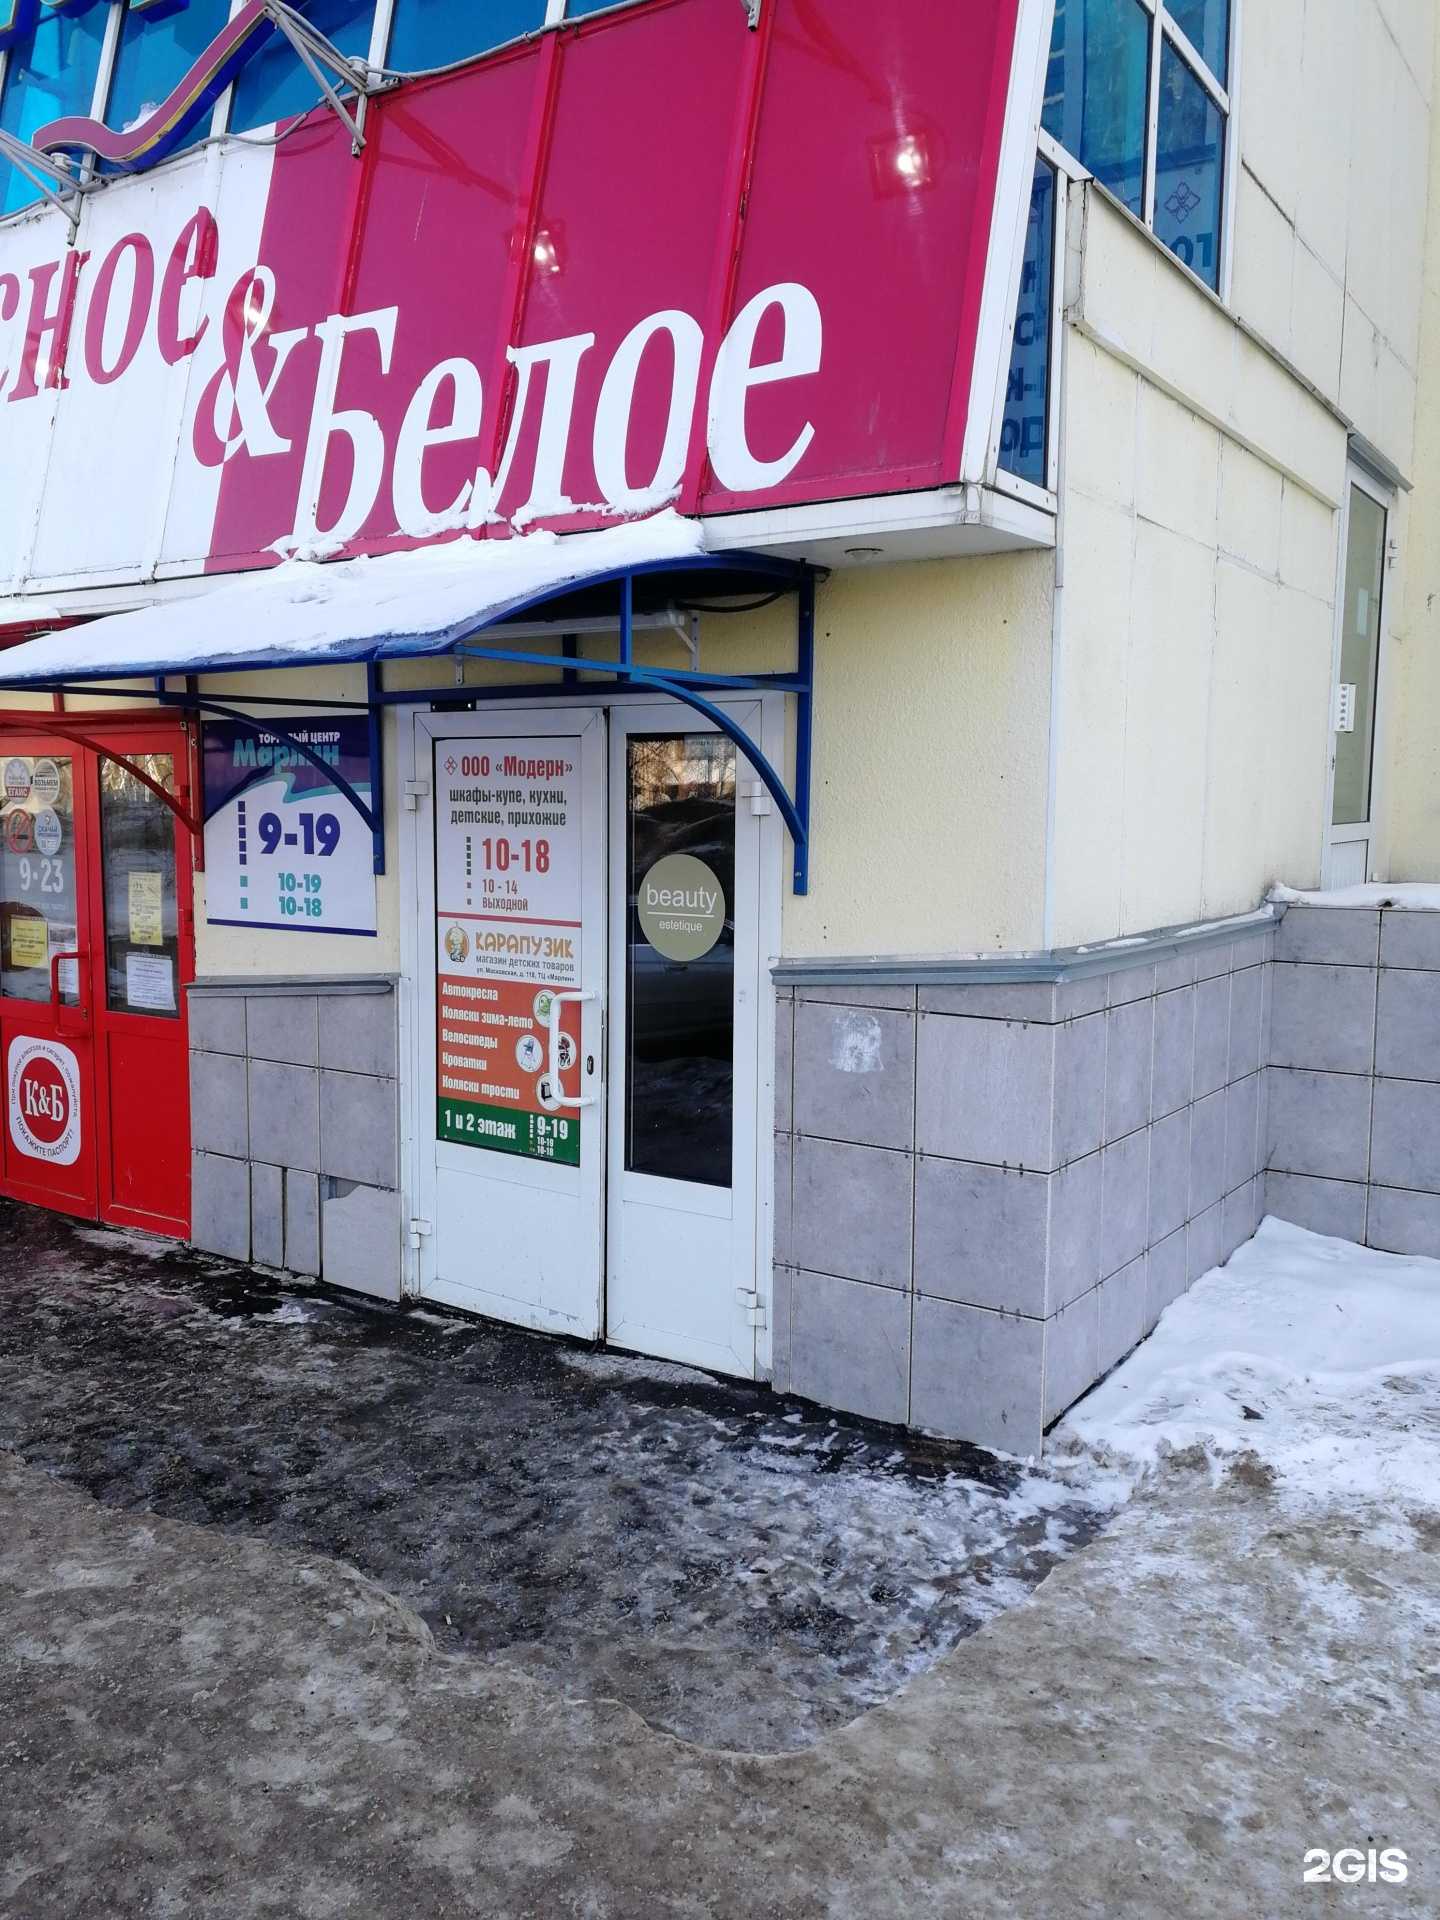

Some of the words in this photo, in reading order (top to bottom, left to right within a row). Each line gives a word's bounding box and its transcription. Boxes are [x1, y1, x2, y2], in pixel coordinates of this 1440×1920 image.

[291, 282, 823, 542] Белое
[310, 732, 340, 745] ЦЕНТР
[461, 756, 490, 776] ООО
[495, 756, 573, 781] «Модерн»
[449, 787, 526, 806] шкафы-купе,
[529, 790, 567, 807] кухни,
[451, 810, 504, 826] детские,
[508, 811, 566, 827] прихожие
[258, 812, 340, 856] 9-19
[482, 838, 550, 873] 10-18
[278, 872, 322, 893] 10-19
[482, 879, 495, 893] 10
[506, 880, 518, 894] 14
[278, 896, 322, 917] 10-18
[647, 883, 717, 913] beauty
[658, 918, 703, 932] estetique
[475, 931, 574, 959] КАРАПУЗИК
[476, 955, 507, 966] магазин
[509, 957, 540, 969] детских
[543, 961, 575, 973] товаров
[442, 982, 498, 1001] Автокресла
[442, 1005, 479, 1022] Коляски
[482, 1011, 533, 1029] зима-лето
[442, 1029, 498, 1050] Велосипеды
[442, 1052, 487, 1071] Кроватки
[442, 1075, 479, 1093] Коляски
[481, 1082, 520, 1099] трости
[24, 1078, 64, 1122] К&Б
[444, 1110, 451, 1128] 1
[455, 1113, 464, 1130] и
[466, 1113, 475, 1132] 2
[477, 1118, 517, 1139] этаж
[537, 1116, 569, 1140] 9-19
